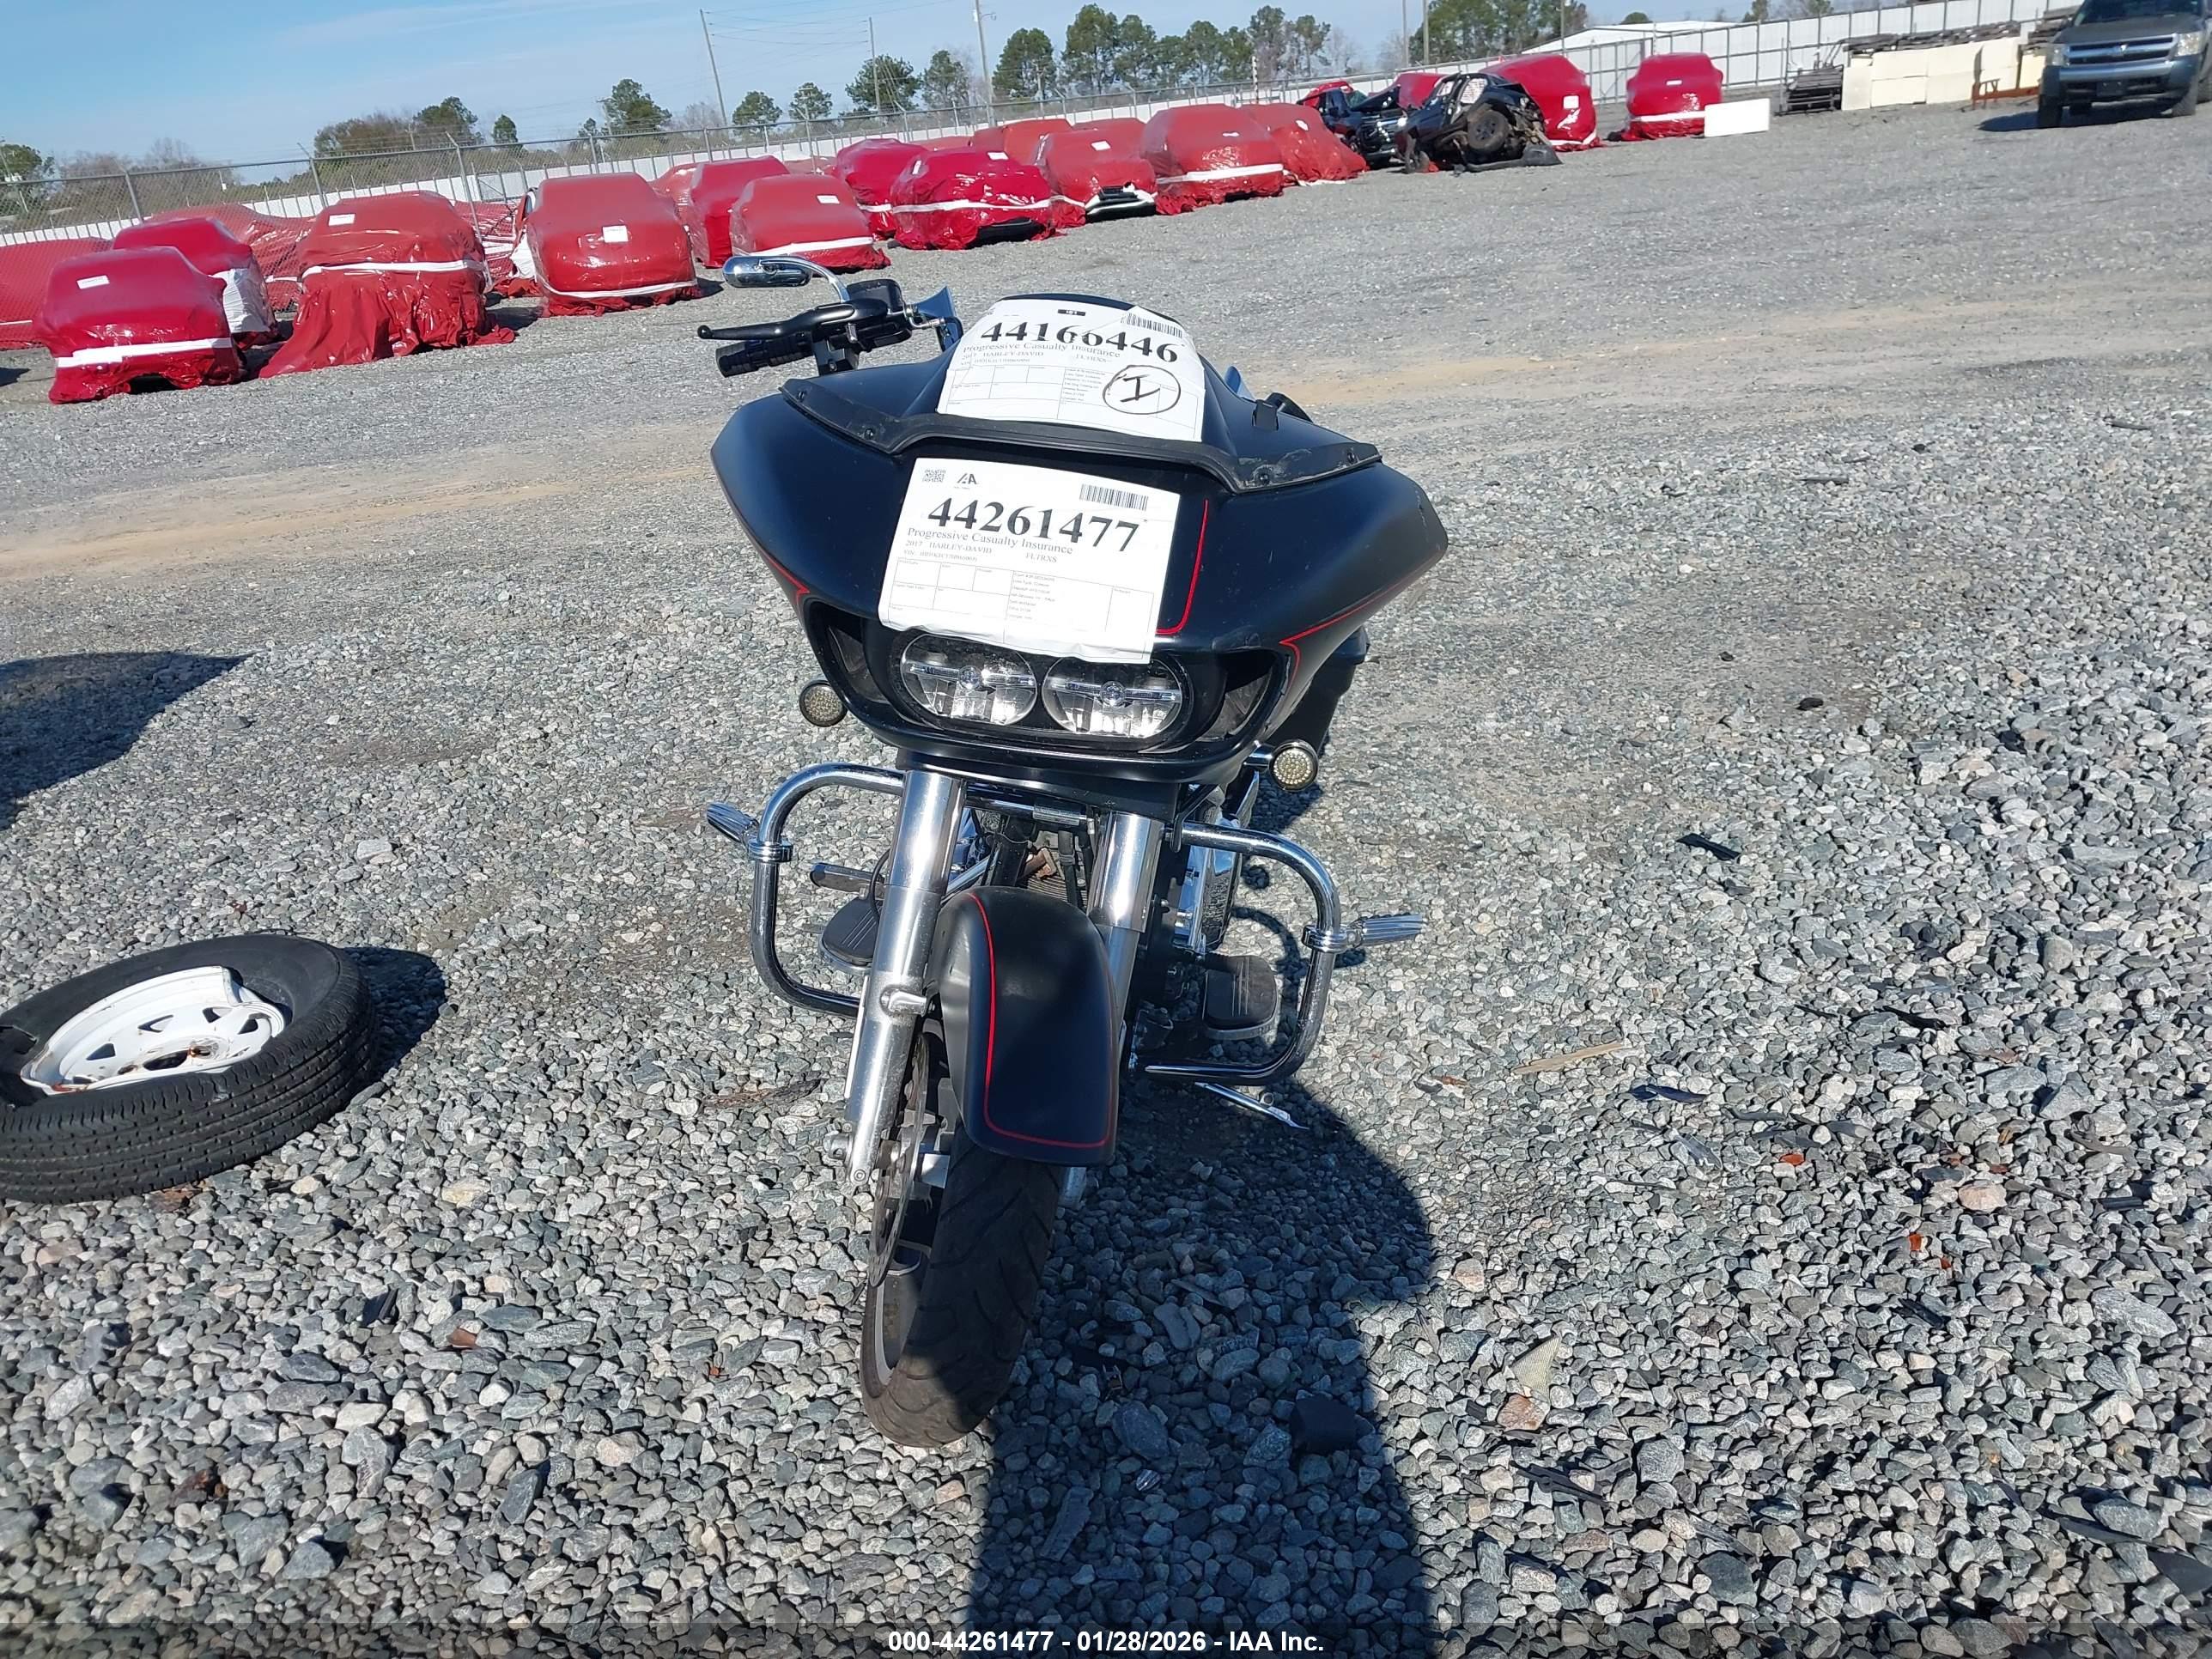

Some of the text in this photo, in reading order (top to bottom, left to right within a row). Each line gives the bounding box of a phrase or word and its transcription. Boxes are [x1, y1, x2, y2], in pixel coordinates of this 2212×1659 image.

[1024, 343, 1067, 352] Casualty
[1072, 345, 1121, 358] Insurance
[928, 497, 1140, 552] 44261477
[908, 527, 1073, 555] Progressive Casualty Insurance
[929, 542, 993, 554] HARLEY-DAVID
